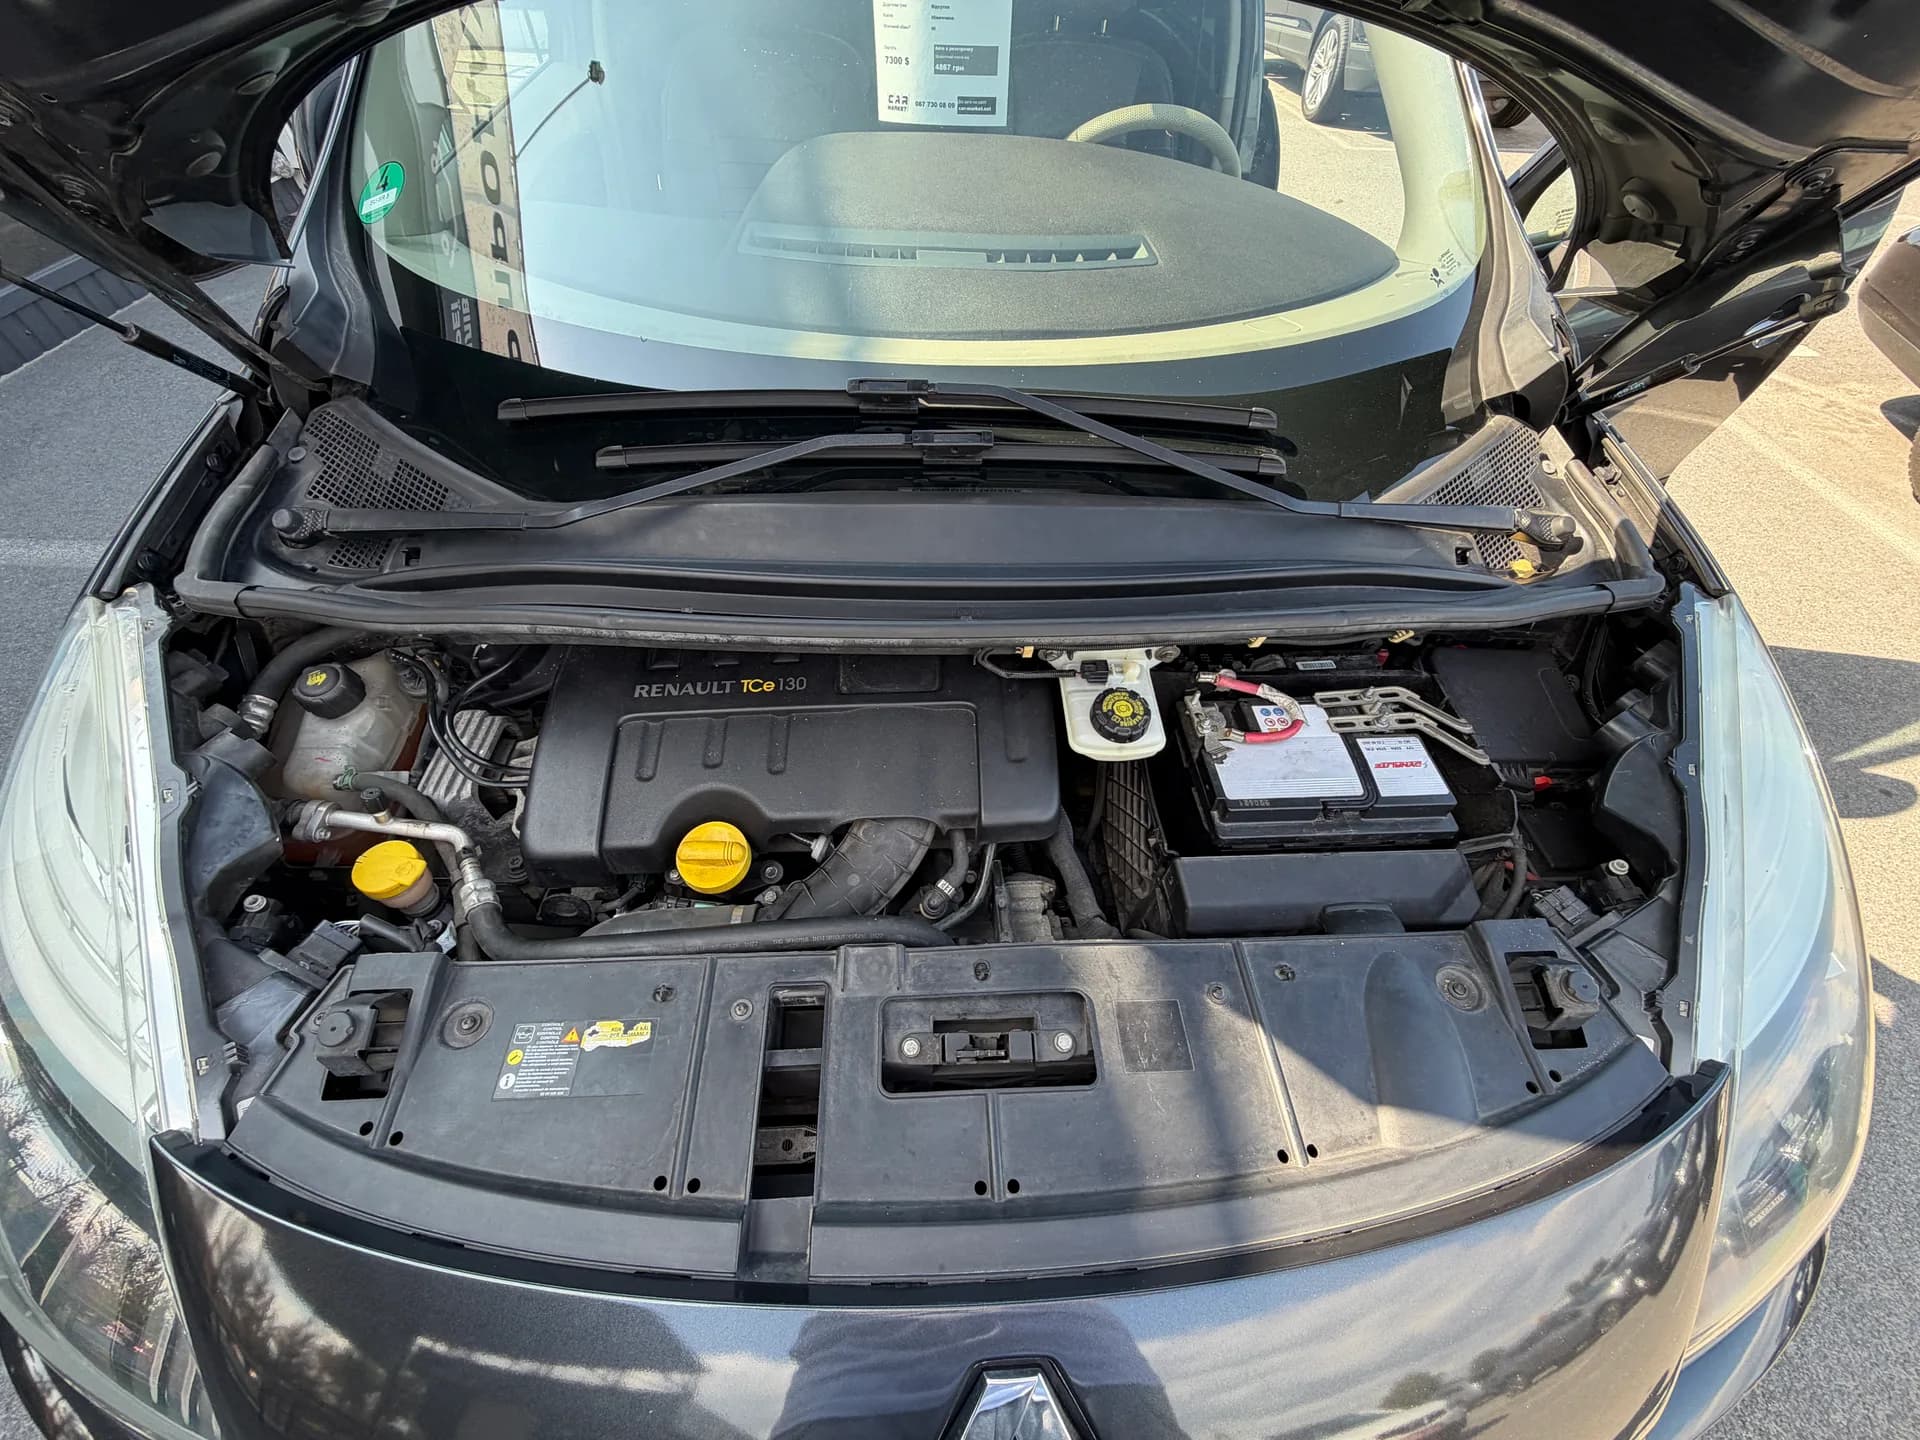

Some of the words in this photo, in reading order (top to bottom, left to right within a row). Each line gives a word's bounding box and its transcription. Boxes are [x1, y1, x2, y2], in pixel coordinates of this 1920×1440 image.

[885, 56, 902, 65] 7300
[904, 57, 910, 66] $
[935, 63, 951, 71] 4867
[888, 94, 909, 105] CAR
[376, 165, 390, 191] 4
[633, 680, 736, 698] RENAULT
[740, 679, 776, 693] TCe
[777, 676, 807, 691] 130
